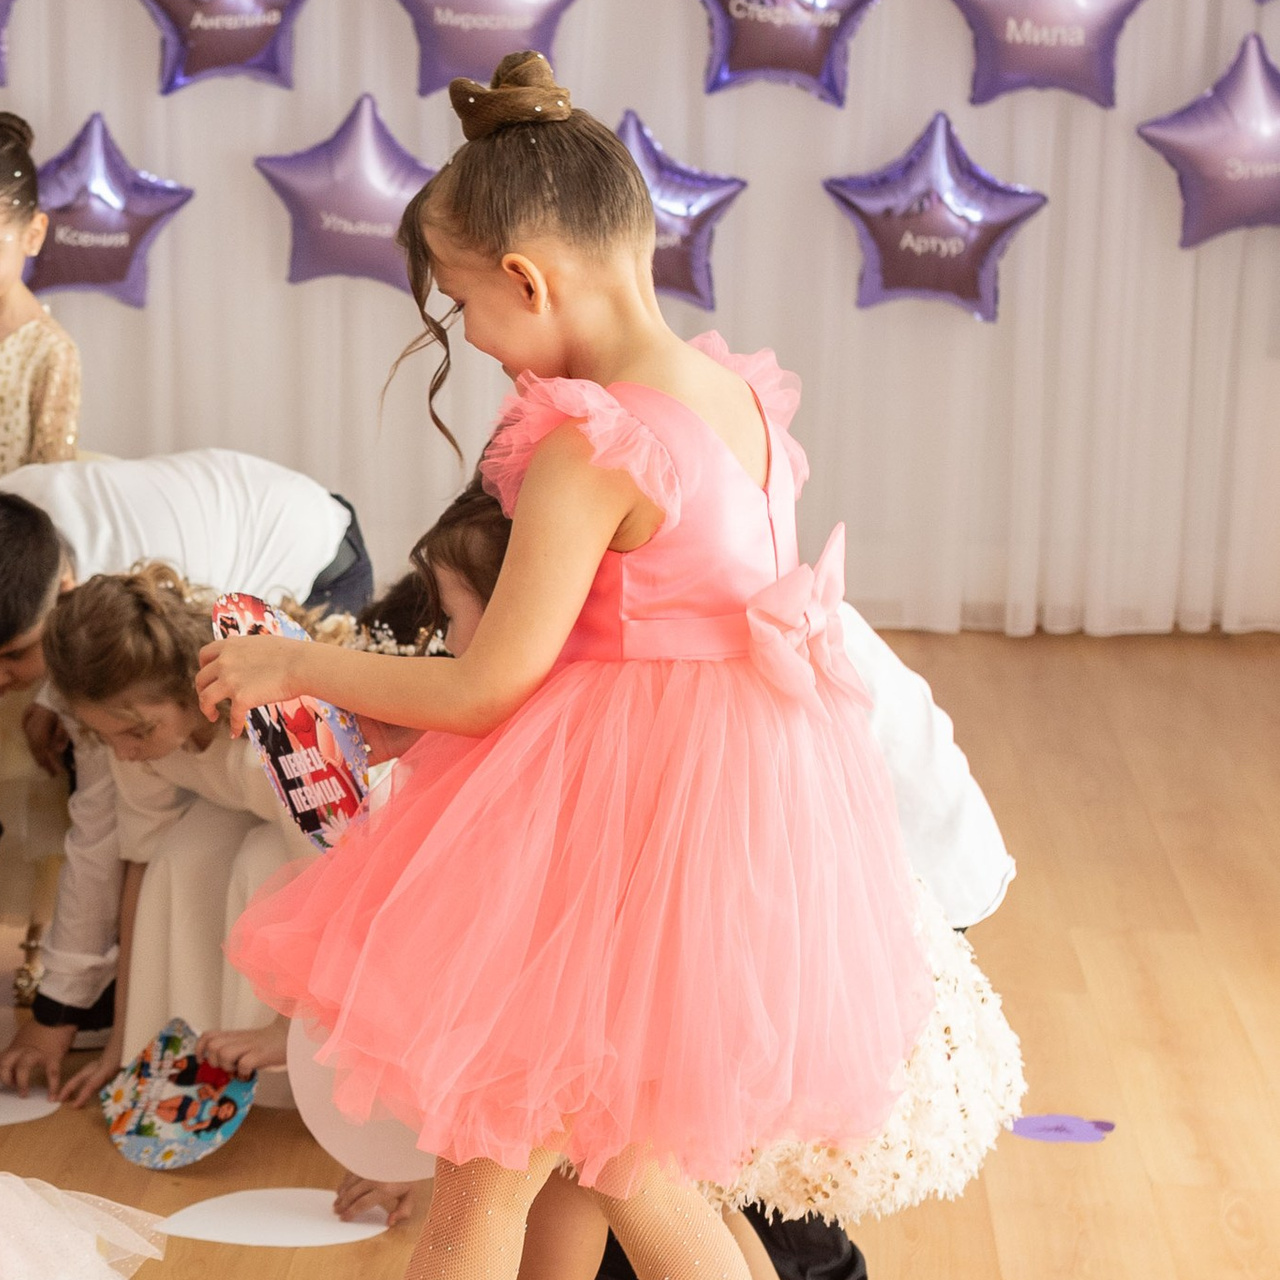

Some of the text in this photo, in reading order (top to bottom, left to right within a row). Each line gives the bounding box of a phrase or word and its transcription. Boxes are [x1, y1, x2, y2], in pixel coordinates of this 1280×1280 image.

[1004, 18, 1085, 46] Мила
[54, 223, 130, 248] Ксения
[899, 229, 966, 258] Артур
[278, 746, 328, 780] ПЕВЕЦ
[288, 775, 347, 814] ПЕВИЦА
